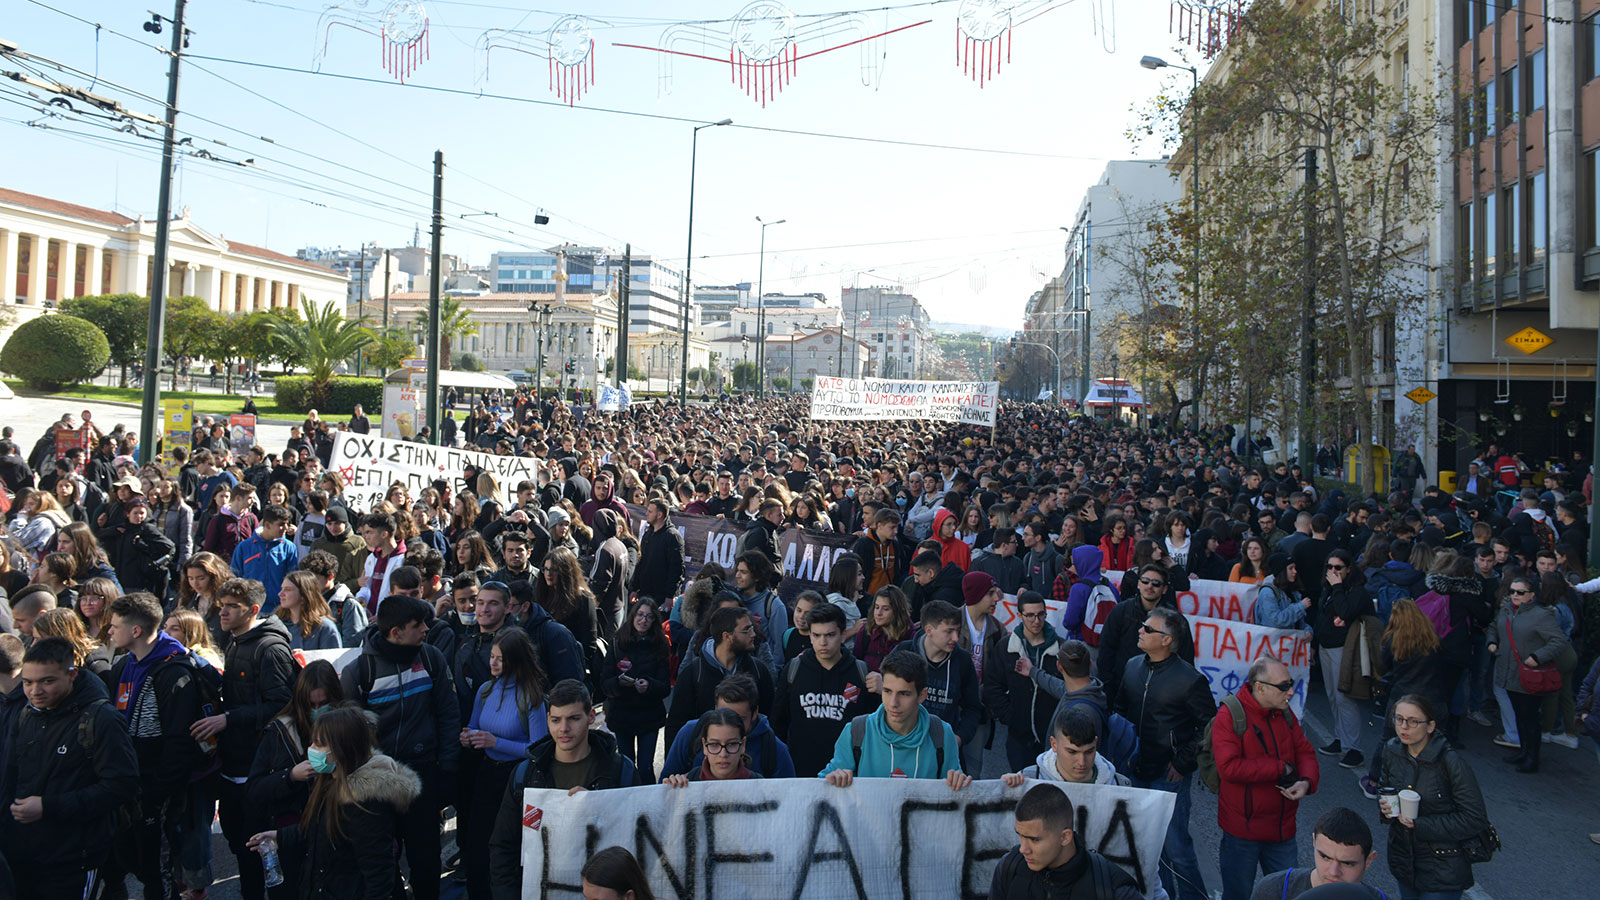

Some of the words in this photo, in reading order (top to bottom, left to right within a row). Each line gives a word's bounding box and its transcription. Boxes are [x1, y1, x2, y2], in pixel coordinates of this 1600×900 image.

[818, 377, 844, 390] ΚΑΤΩ
[848, 379, 858, 392] ΟΙ
[863, 381, 894, 394] ΝΟΜΟΙ
[899, 383, 915, 394] ΚΑΙ
[917, 383, 927, 393] ΟΙ
[931, 383, 988, 394] ΚΑΝΟΝΙΣΜΟΙ
[849, 391, 860, 404] ΤΟ
[932, 394, 994, 408] ΑΝΑΤΡΑΠΕΙ
[963, 408, 991, 422] ΑΘΗΝΑΣ
[447, 451, 531, 480] ΠΑΙΔΕΙΑ
[799, 692, 850, 709] LOONEY
[803, 705, 844, 721] TUNES
[900, 798, 1147, 900] ΓΕΙΑ
